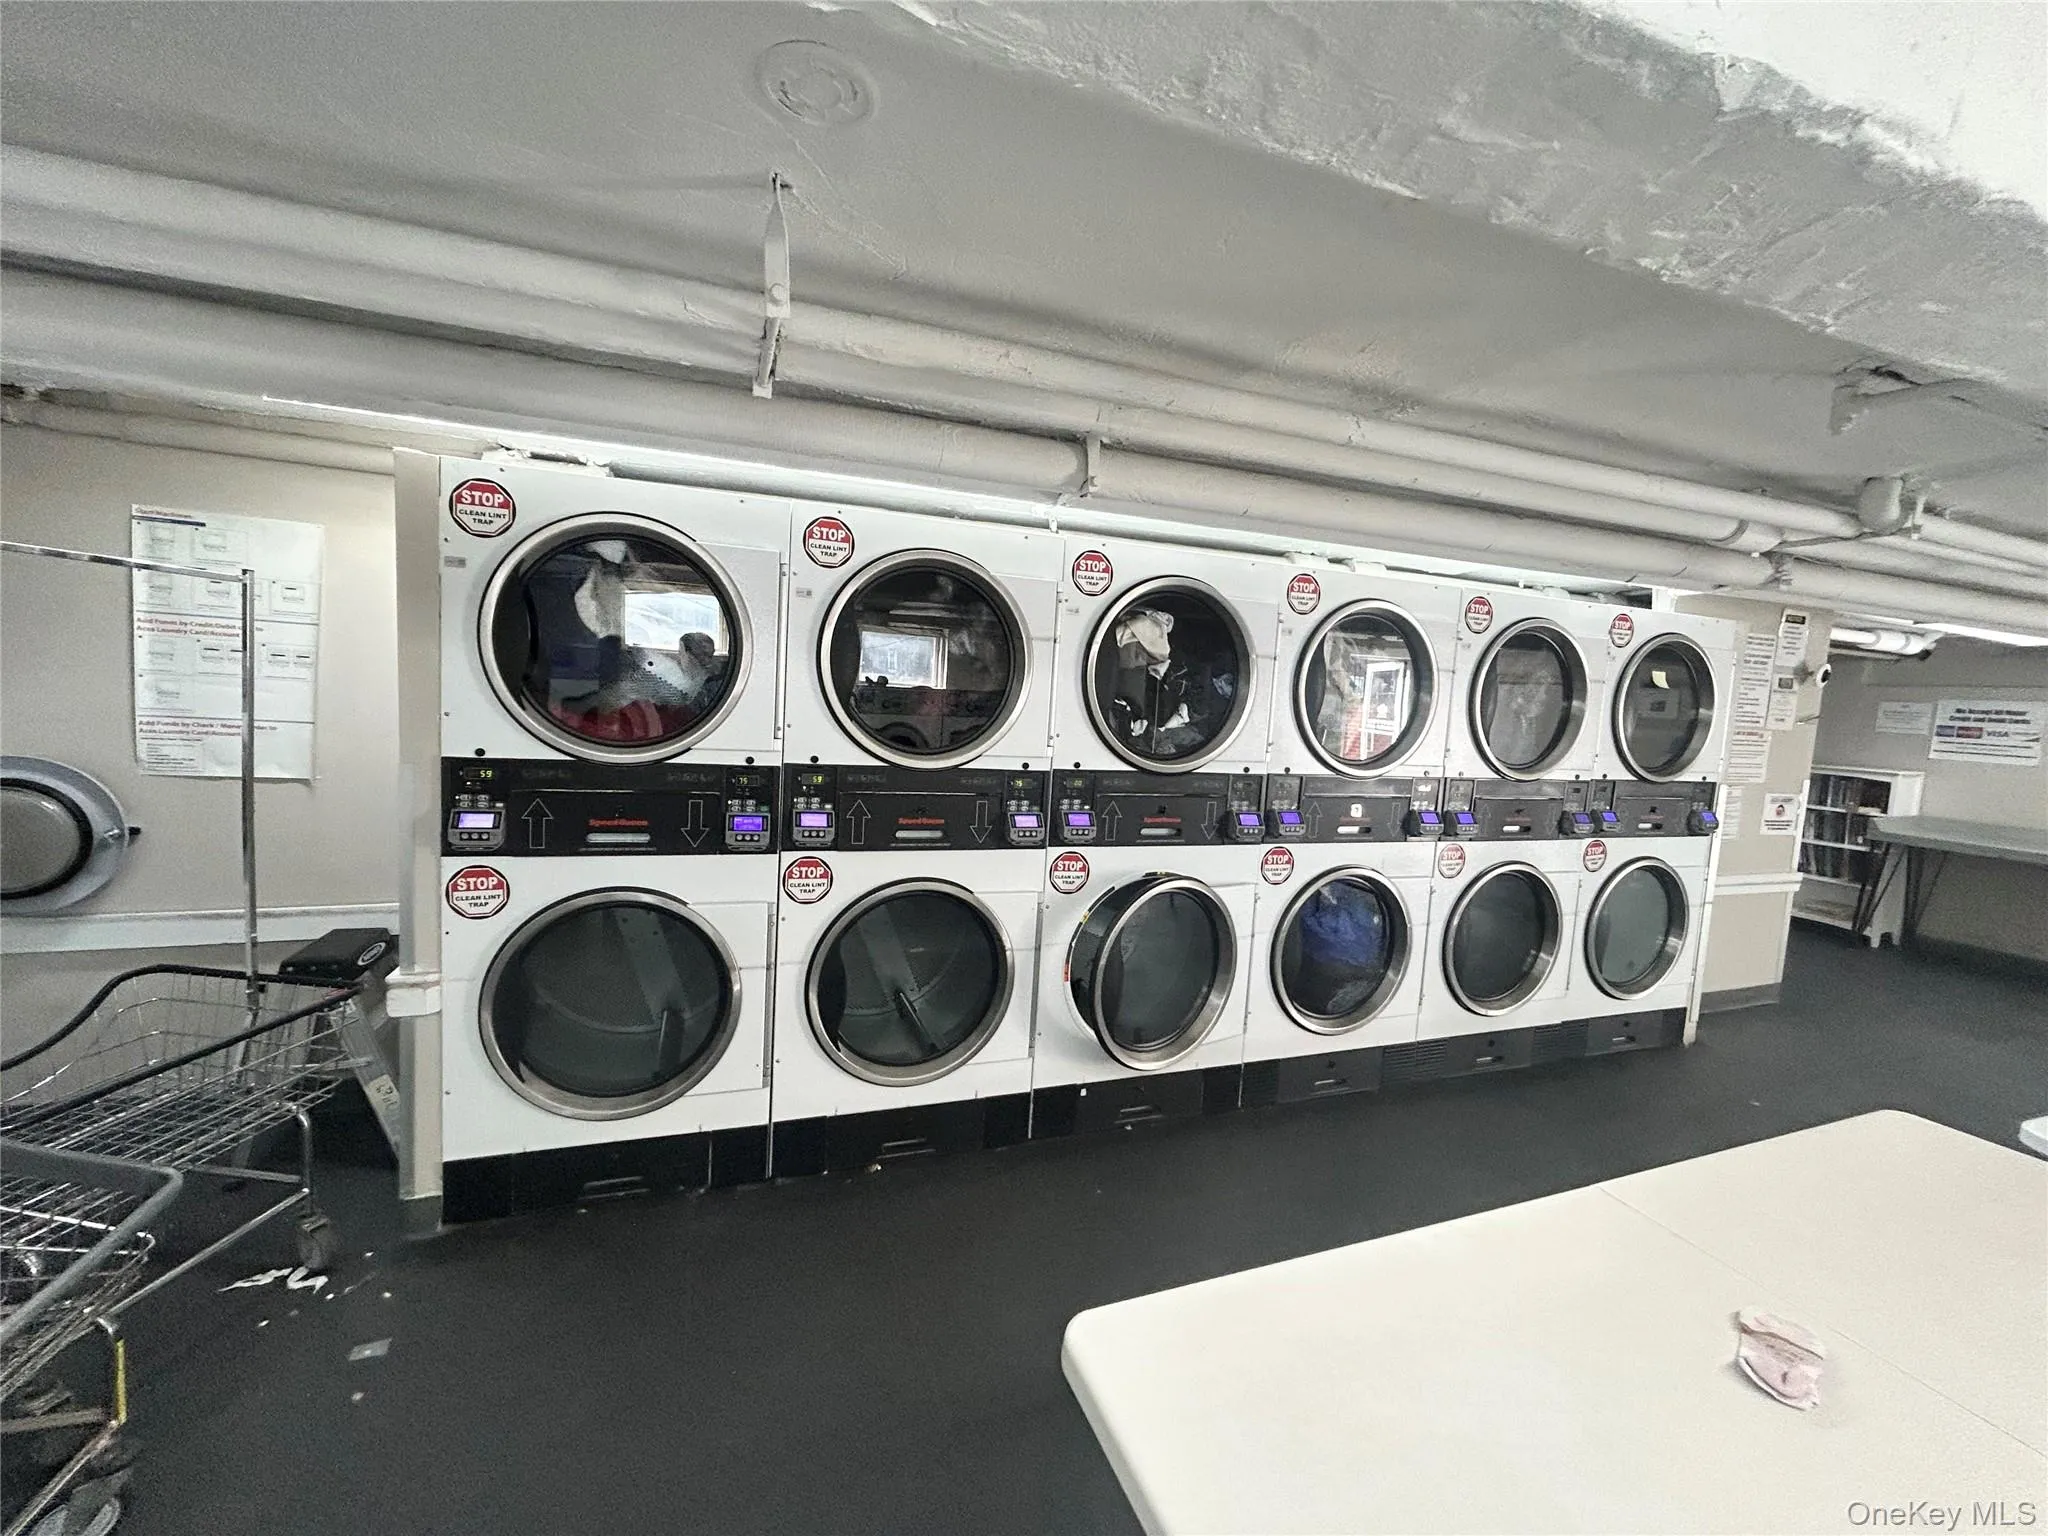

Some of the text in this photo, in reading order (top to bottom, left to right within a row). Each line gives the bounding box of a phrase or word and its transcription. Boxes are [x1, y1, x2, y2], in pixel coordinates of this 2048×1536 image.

[460, 489, 504, 507] STOP
[459, 508, 507, 519] CLEAN LINT
[472, 518, 494, 526] TRAP
[812, 526, 846, 541] STOP
[1079, 560, 1106, 572] STOP
[1293, 582, 1315, 592] STOP
[1470, 604, 1488, 613] STOP
[480, 770, 493, 778] 59
[1267, 854, 1289, 864] STOP
[1443, 851, 1461, 860] STOP
[1057, 860, 1083, 871] STOP
[792, 866, 824, 878] STOP
[456, 876, 498, 890] STOP
